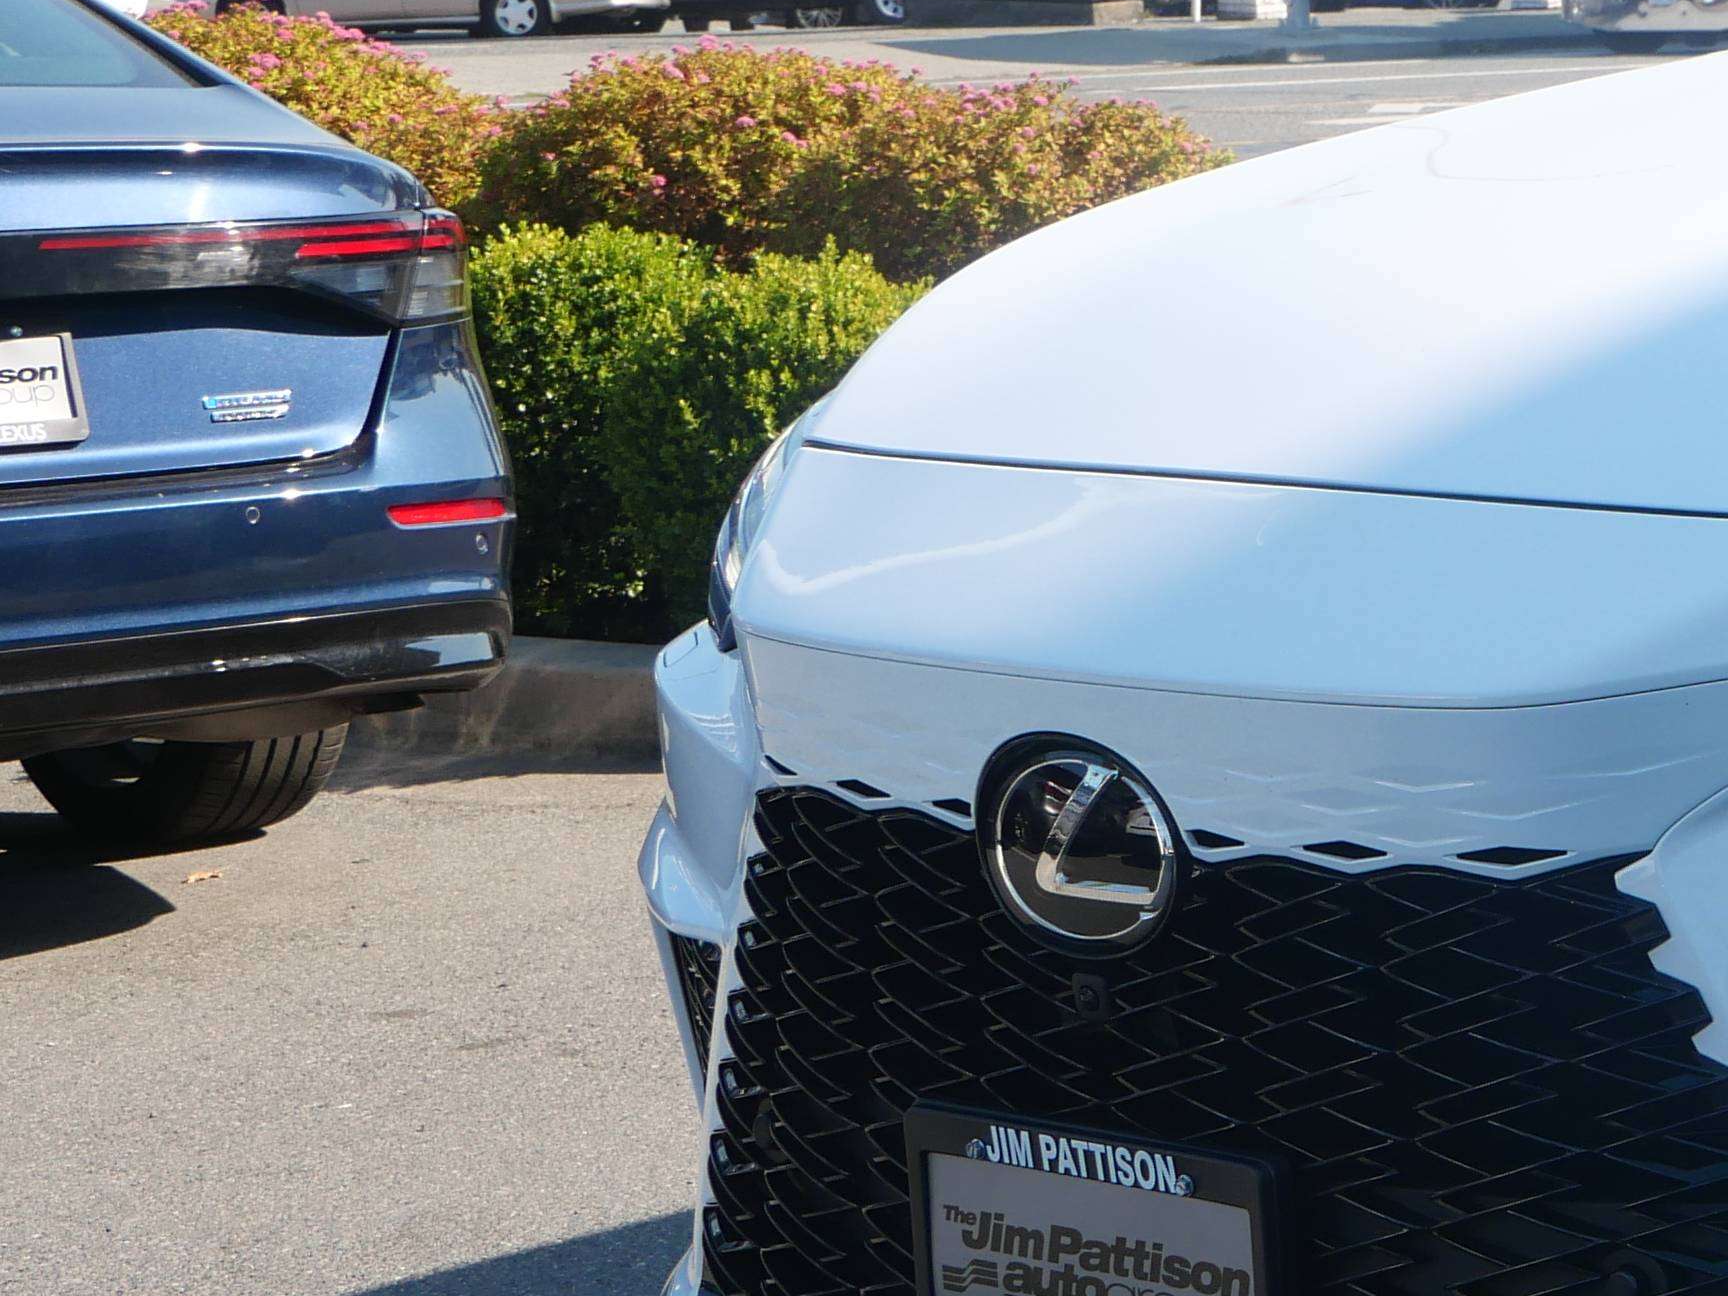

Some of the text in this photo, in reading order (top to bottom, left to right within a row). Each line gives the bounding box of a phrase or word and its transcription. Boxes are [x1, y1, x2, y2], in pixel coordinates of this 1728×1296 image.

[0, 423, 47, 441] EXUS
[985, 1125, 1178, 1195] JIM PATTISON
[943, 1204, 976, 1225] The
